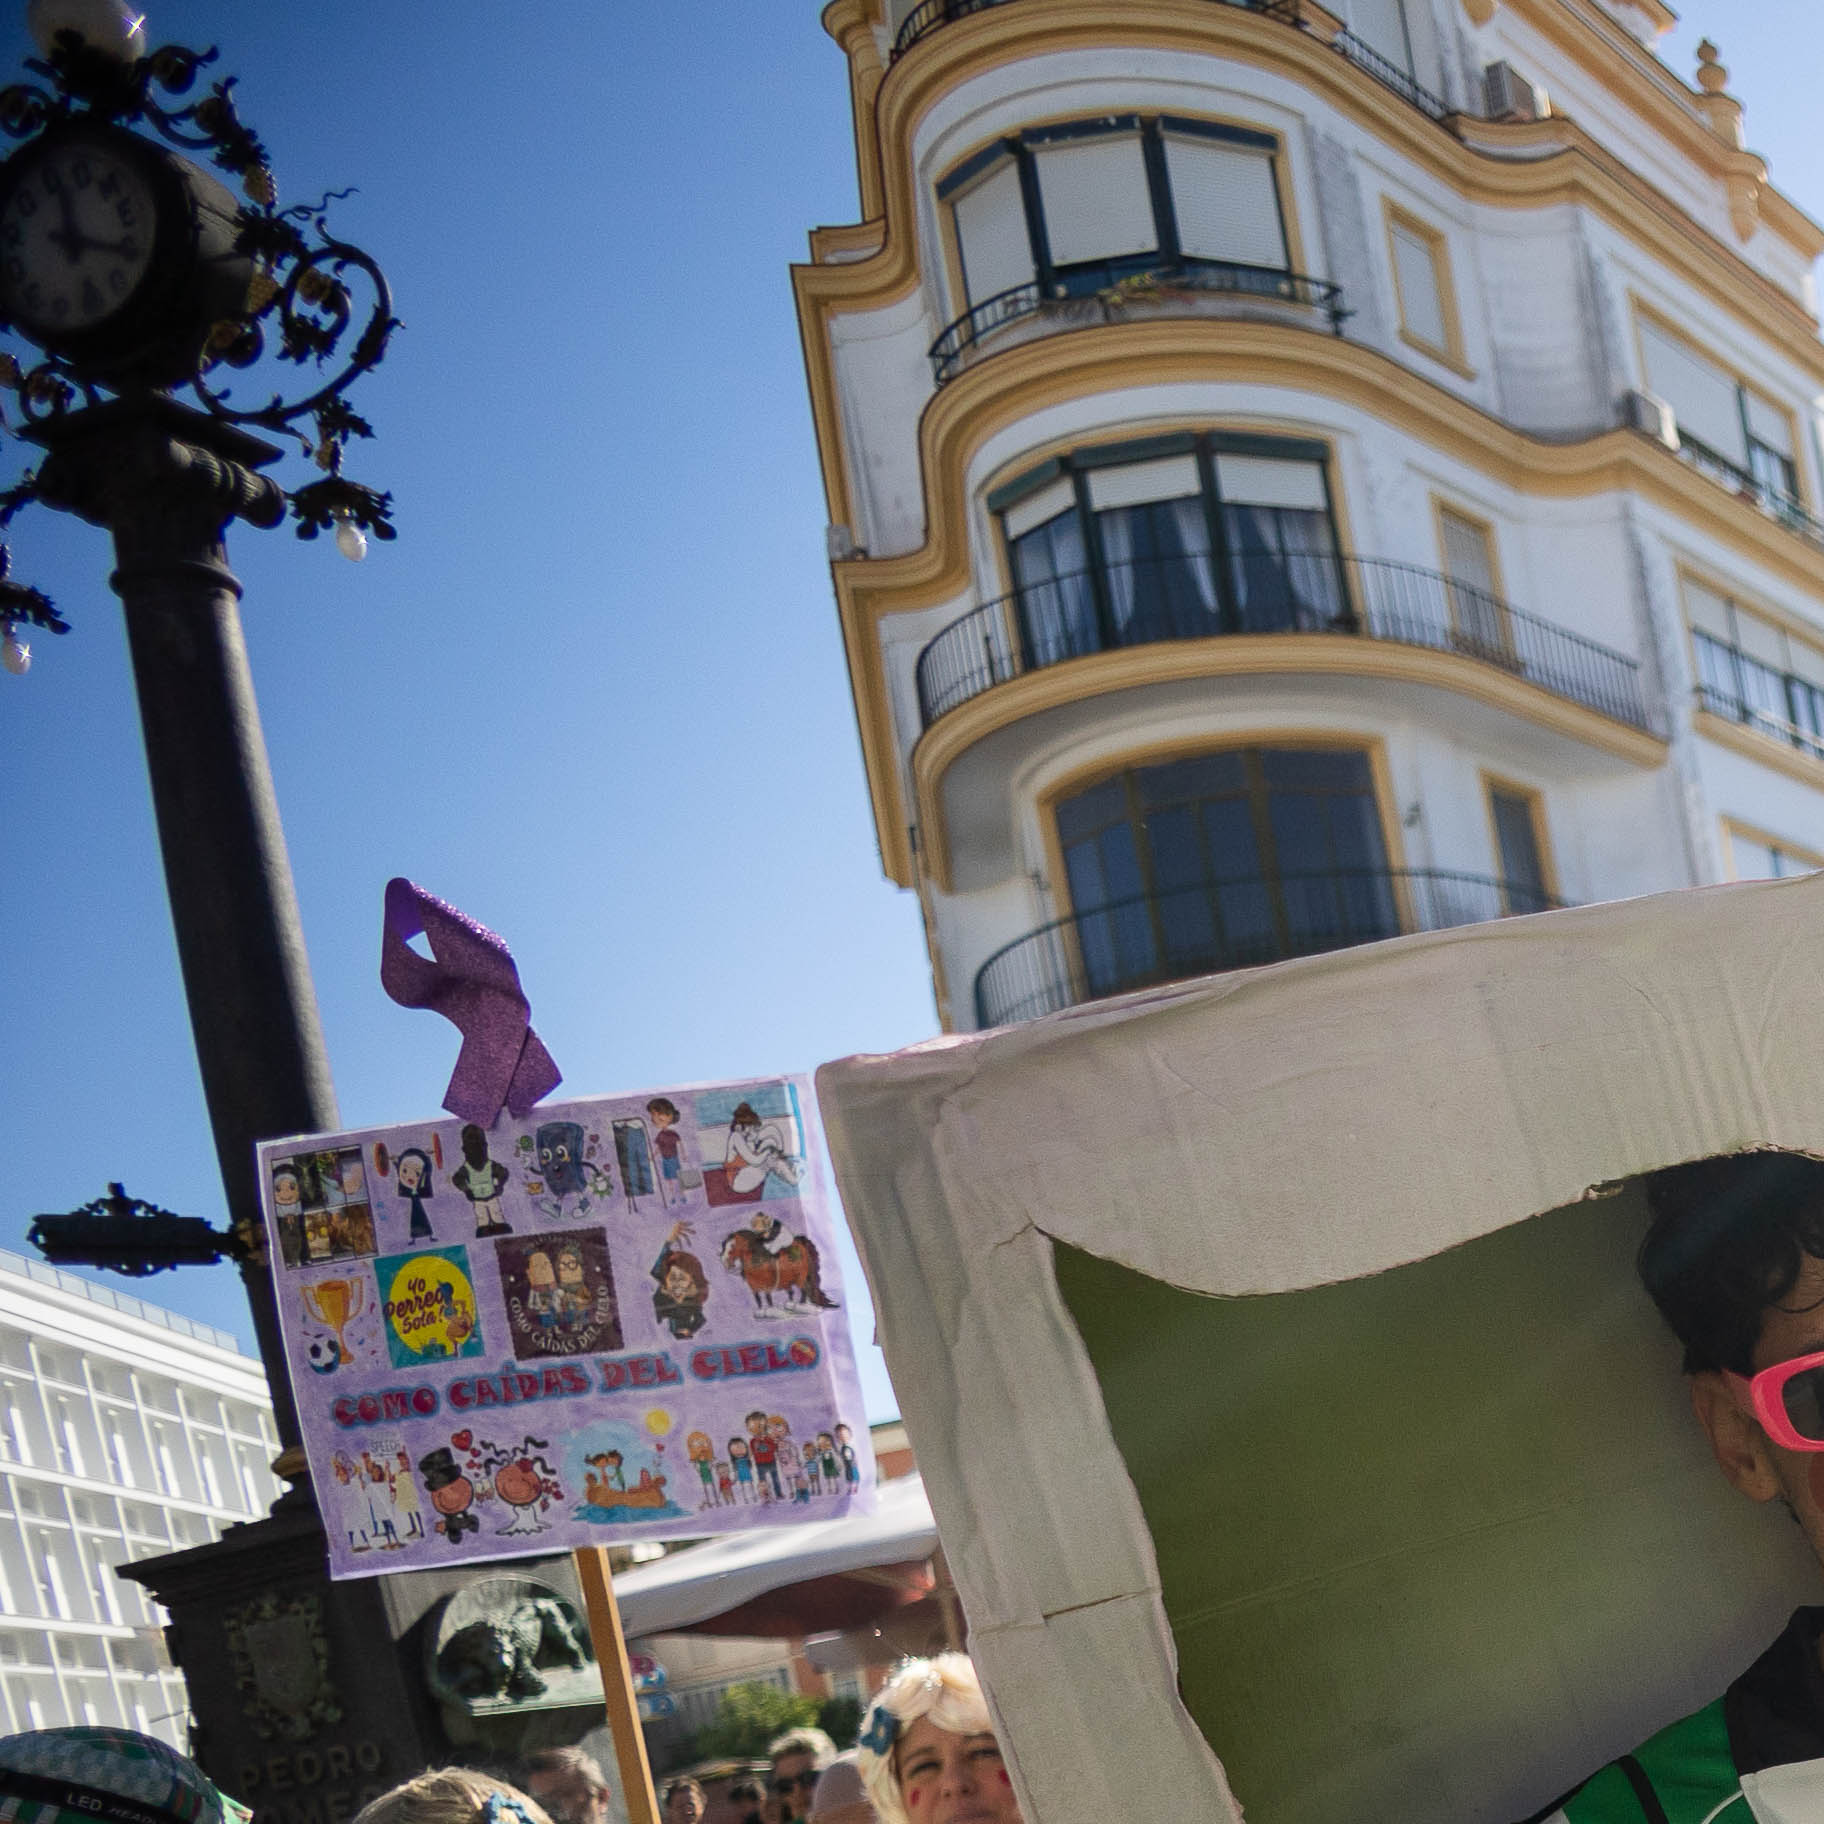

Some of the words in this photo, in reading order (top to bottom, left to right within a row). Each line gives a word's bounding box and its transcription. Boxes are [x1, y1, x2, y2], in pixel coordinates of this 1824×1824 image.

[333, 1385, 437, 1425] COMO
[449, 1362, 589, 1408] CAÍDAS
[602, 1355, 680, 1388] DEL
[692, 1339, 818, 1378] CIELO
[67, 1793, 103, 1812] LED
